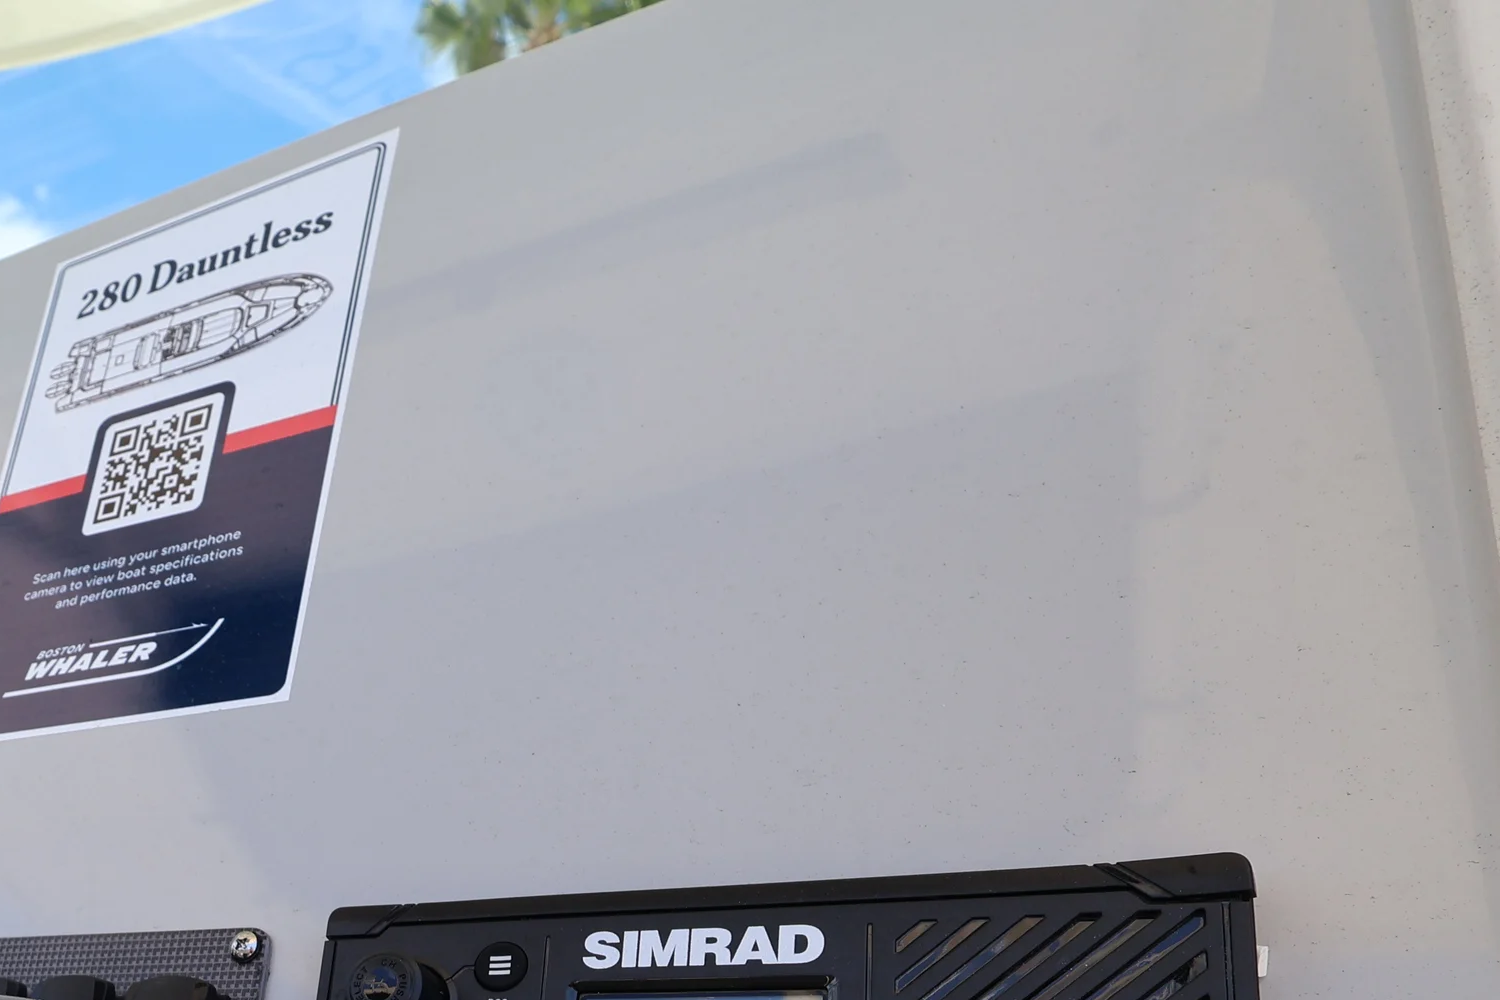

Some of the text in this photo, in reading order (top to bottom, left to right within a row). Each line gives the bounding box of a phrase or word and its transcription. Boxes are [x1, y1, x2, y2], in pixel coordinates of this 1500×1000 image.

[77, 211, 334, 320] 280 Dauntless
[24, 545, 243, 601] camera to view boat specifications
[32, 530, 242, 585] Scan here using your smartphone
[55, 573, 197, 609] and performance data.
[25, 641, 158, 681] WHALER
[36, 643, 85, 660] BOSTON
[582, 924, 825, 969] SIMRAD
